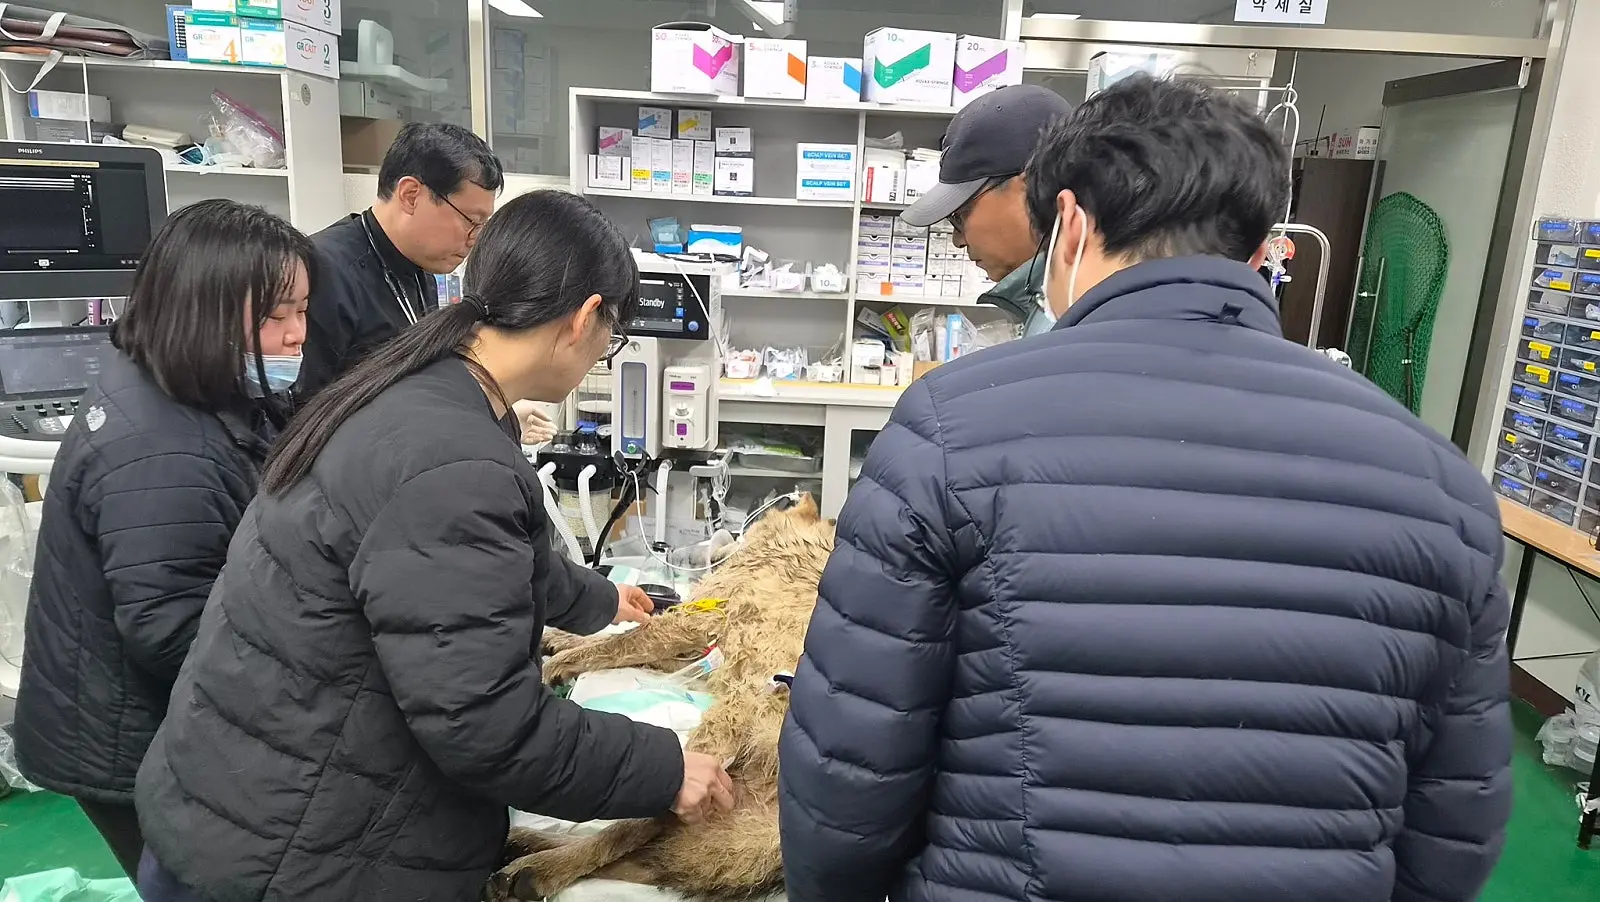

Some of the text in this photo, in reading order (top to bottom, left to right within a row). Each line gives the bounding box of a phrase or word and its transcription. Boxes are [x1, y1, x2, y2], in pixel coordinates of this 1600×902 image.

[223, 38, 238, 64] 4
[323, 43, 331, 65] 2
[639, 296, 665, 309] Standby
